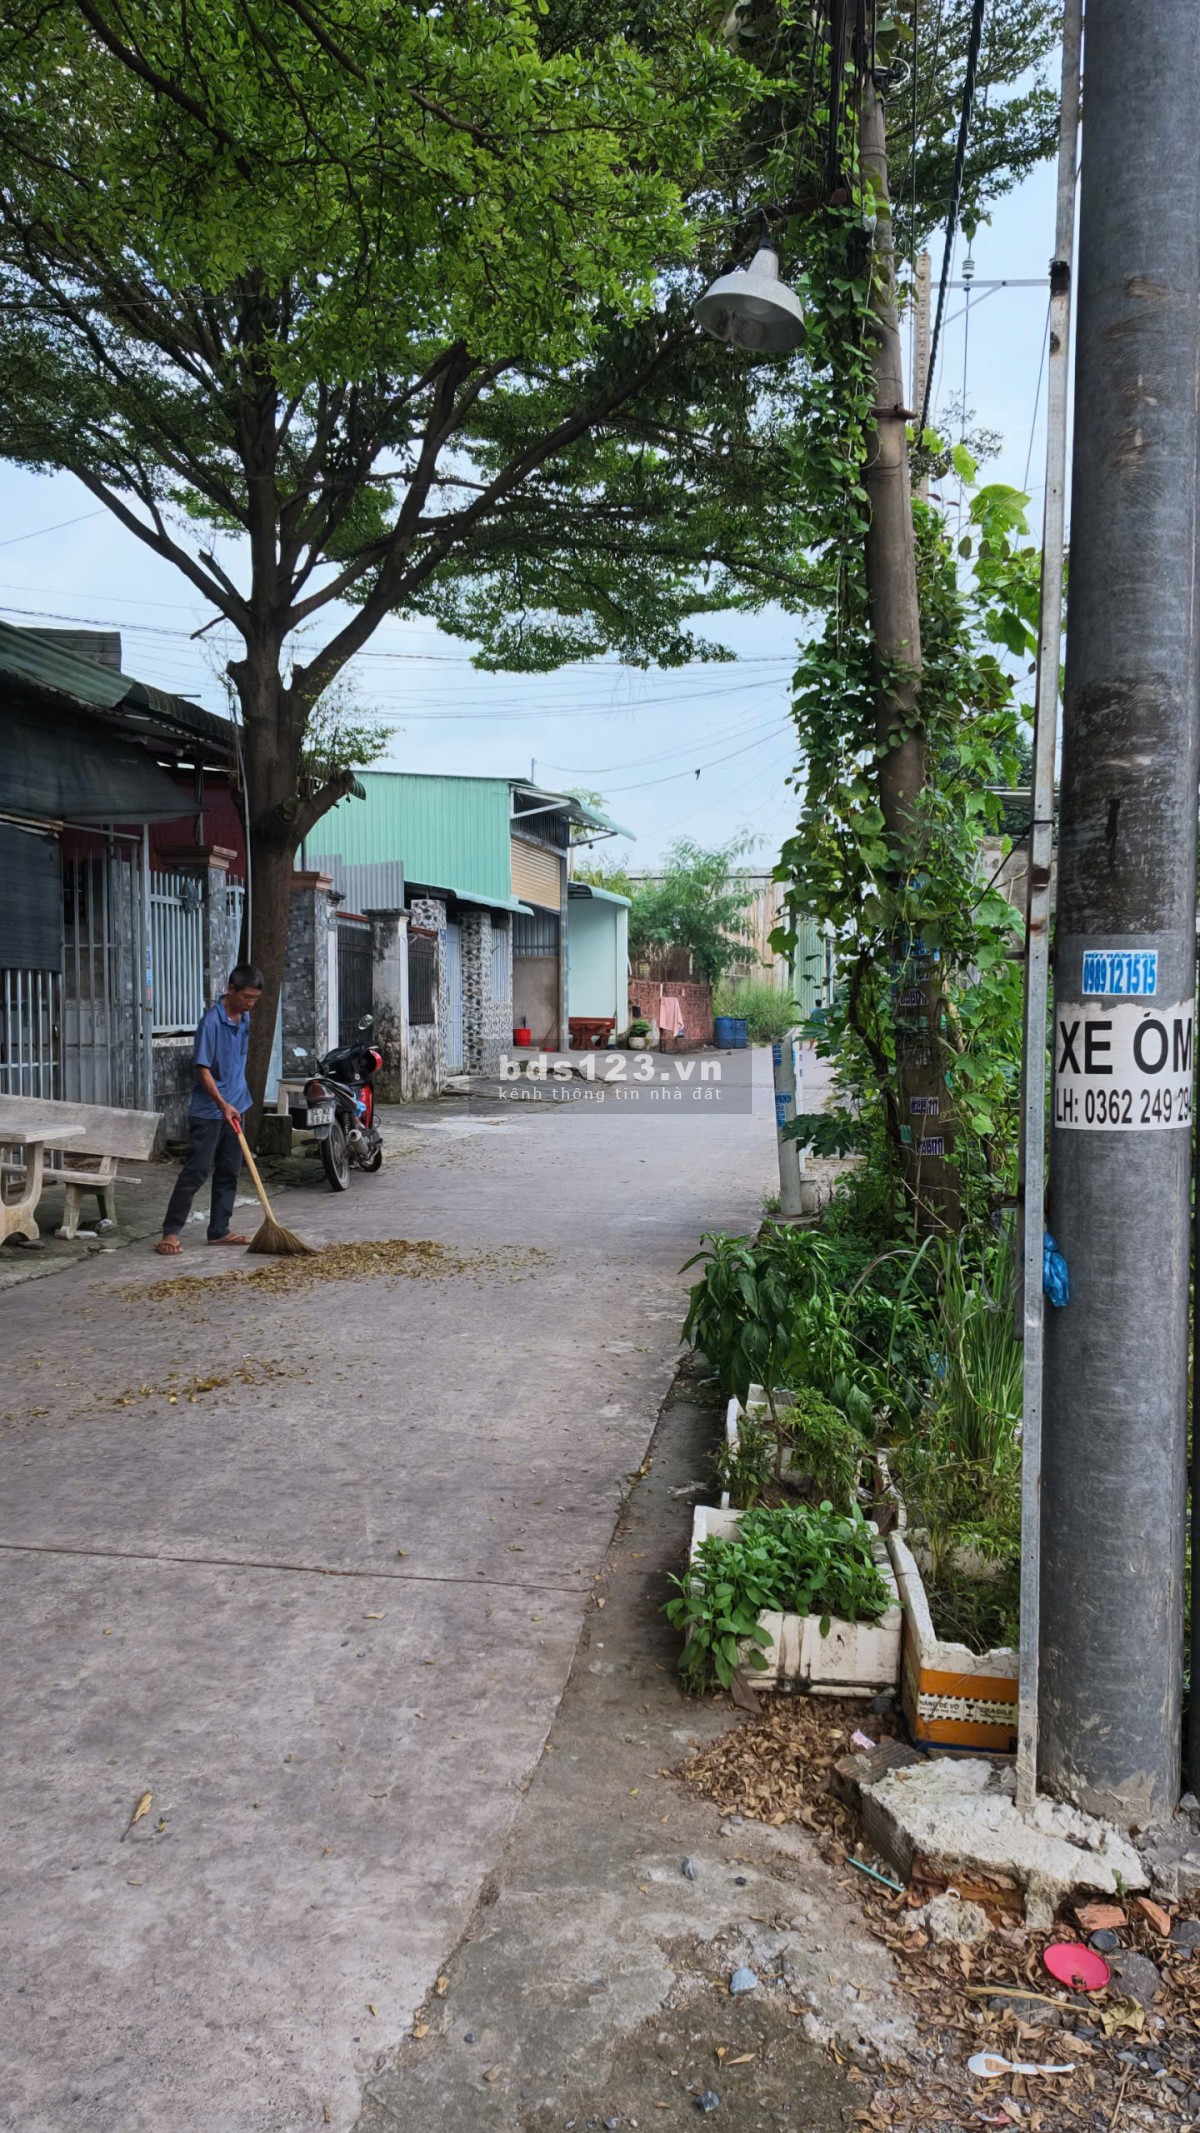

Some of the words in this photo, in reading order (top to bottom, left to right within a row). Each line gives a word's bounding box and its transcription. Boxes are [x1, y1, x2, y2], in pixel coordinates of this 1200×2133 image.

[1058, 1020, 1113, 1075] XE
[1056, 1088, 1078, 1123] LH:
[1085, 1089, 1132, 1124] 0362
[1140, 1088, 1172, 1124] 249
